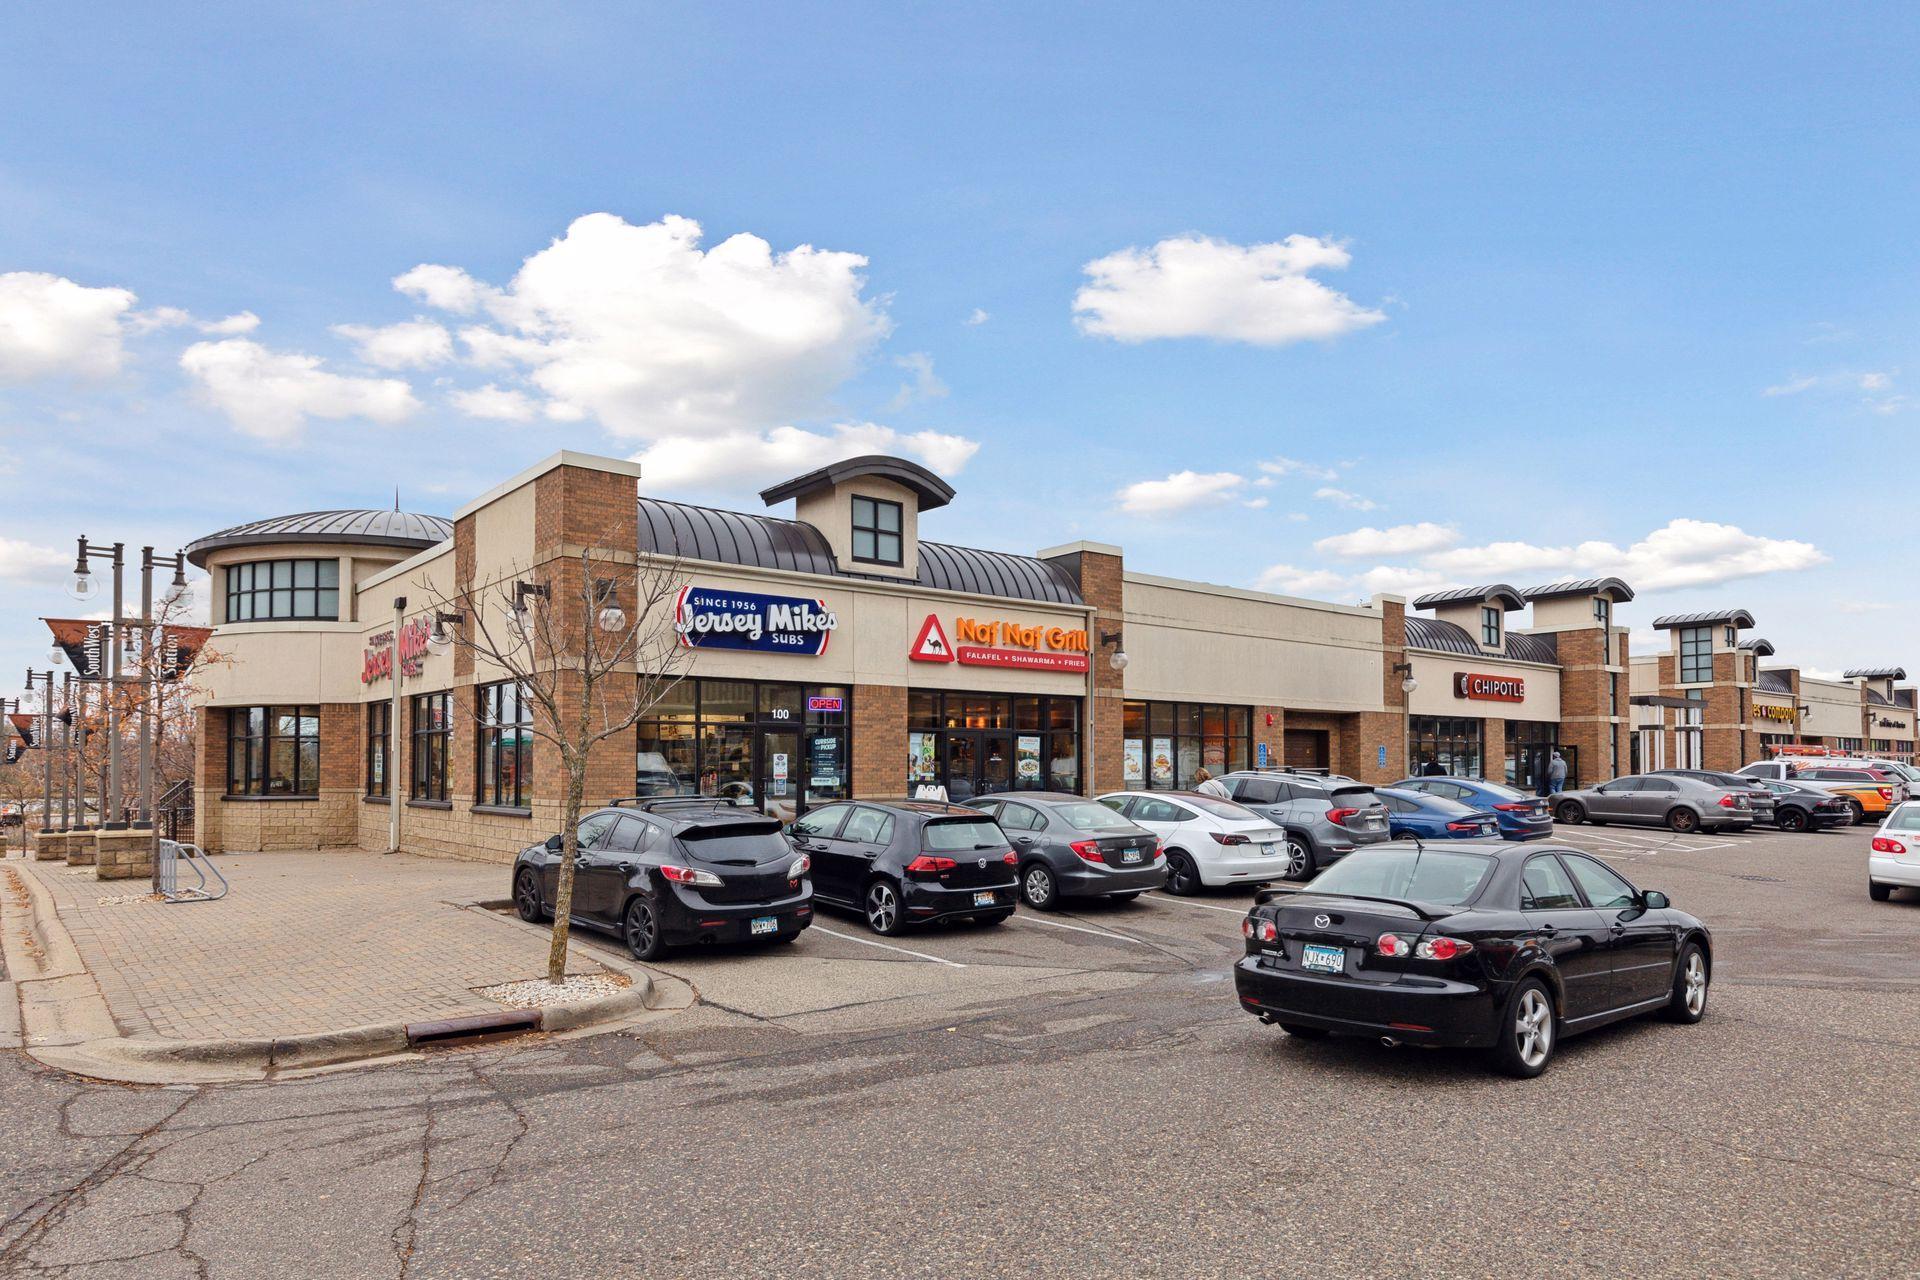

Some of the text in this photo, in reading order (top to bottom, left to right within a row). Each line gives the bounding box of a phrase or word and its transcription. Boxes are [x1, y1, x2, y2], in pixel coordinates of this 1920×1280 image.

[693, 597, 757, 611] SINCE 1956
[675, 603, 838, 640] Jersey Mike's
[772, 633, 805, 646] SUBS
[956, 616, 1089, 651] Naf Naf Grill
[83, 623, 102, 677] SouthWest
[161, 634, 178, 677] Station
[966, 652, 1086, 668] FALAFEL SHAWARMA FRIES
[1474, 679, 1525, 697] CHIPOTLE
[811, 699, 840, 709] OPEN
[771, 709, 789, 719] 100
